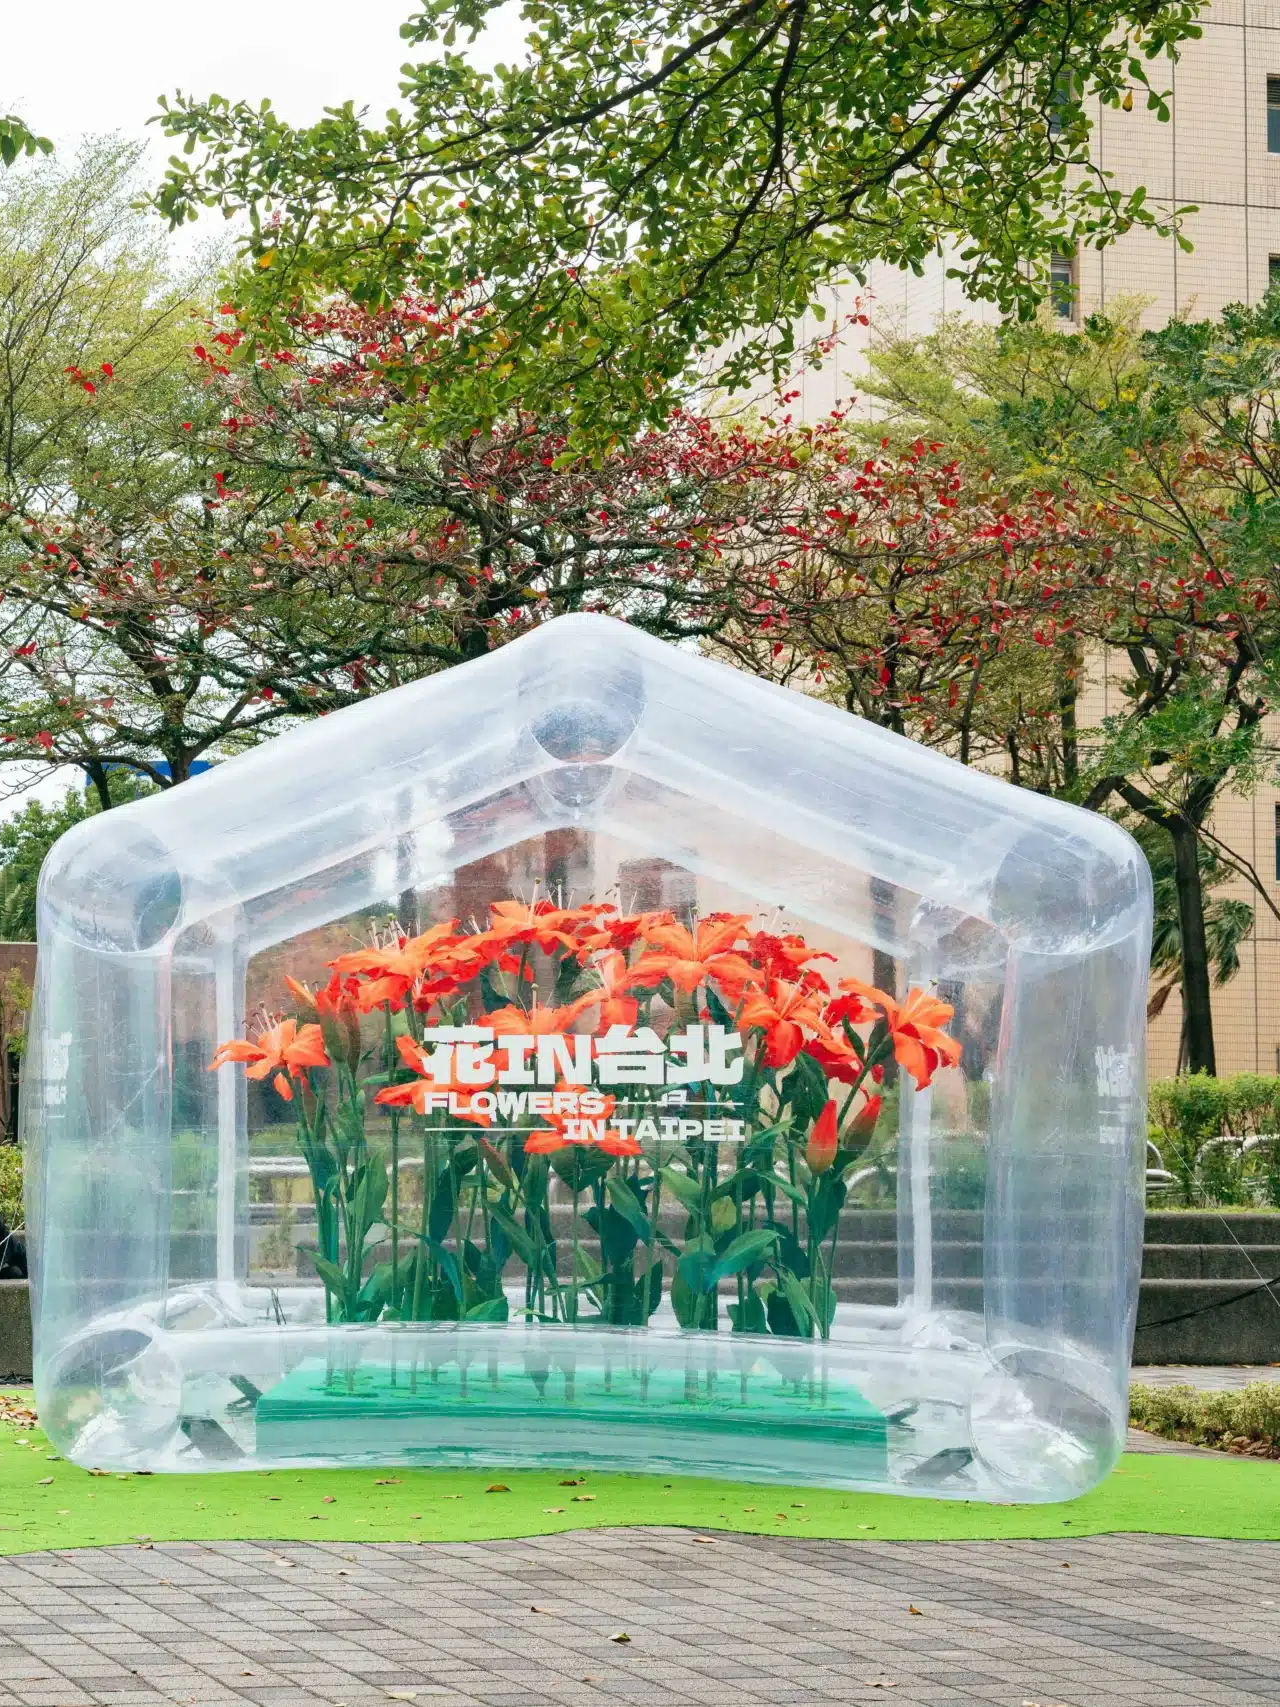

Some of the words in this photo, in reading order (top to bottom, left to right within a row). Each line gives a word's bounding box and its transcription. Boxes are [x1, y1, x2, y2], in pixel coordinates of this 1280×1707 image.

[421, 1024, 744, 1085] 花IN台北
[423, 1091, 605, 1115] FLOWERS
[562, 1119, 605, 1141] IN
[611, 1119, 746, 1142] TAIPEI
